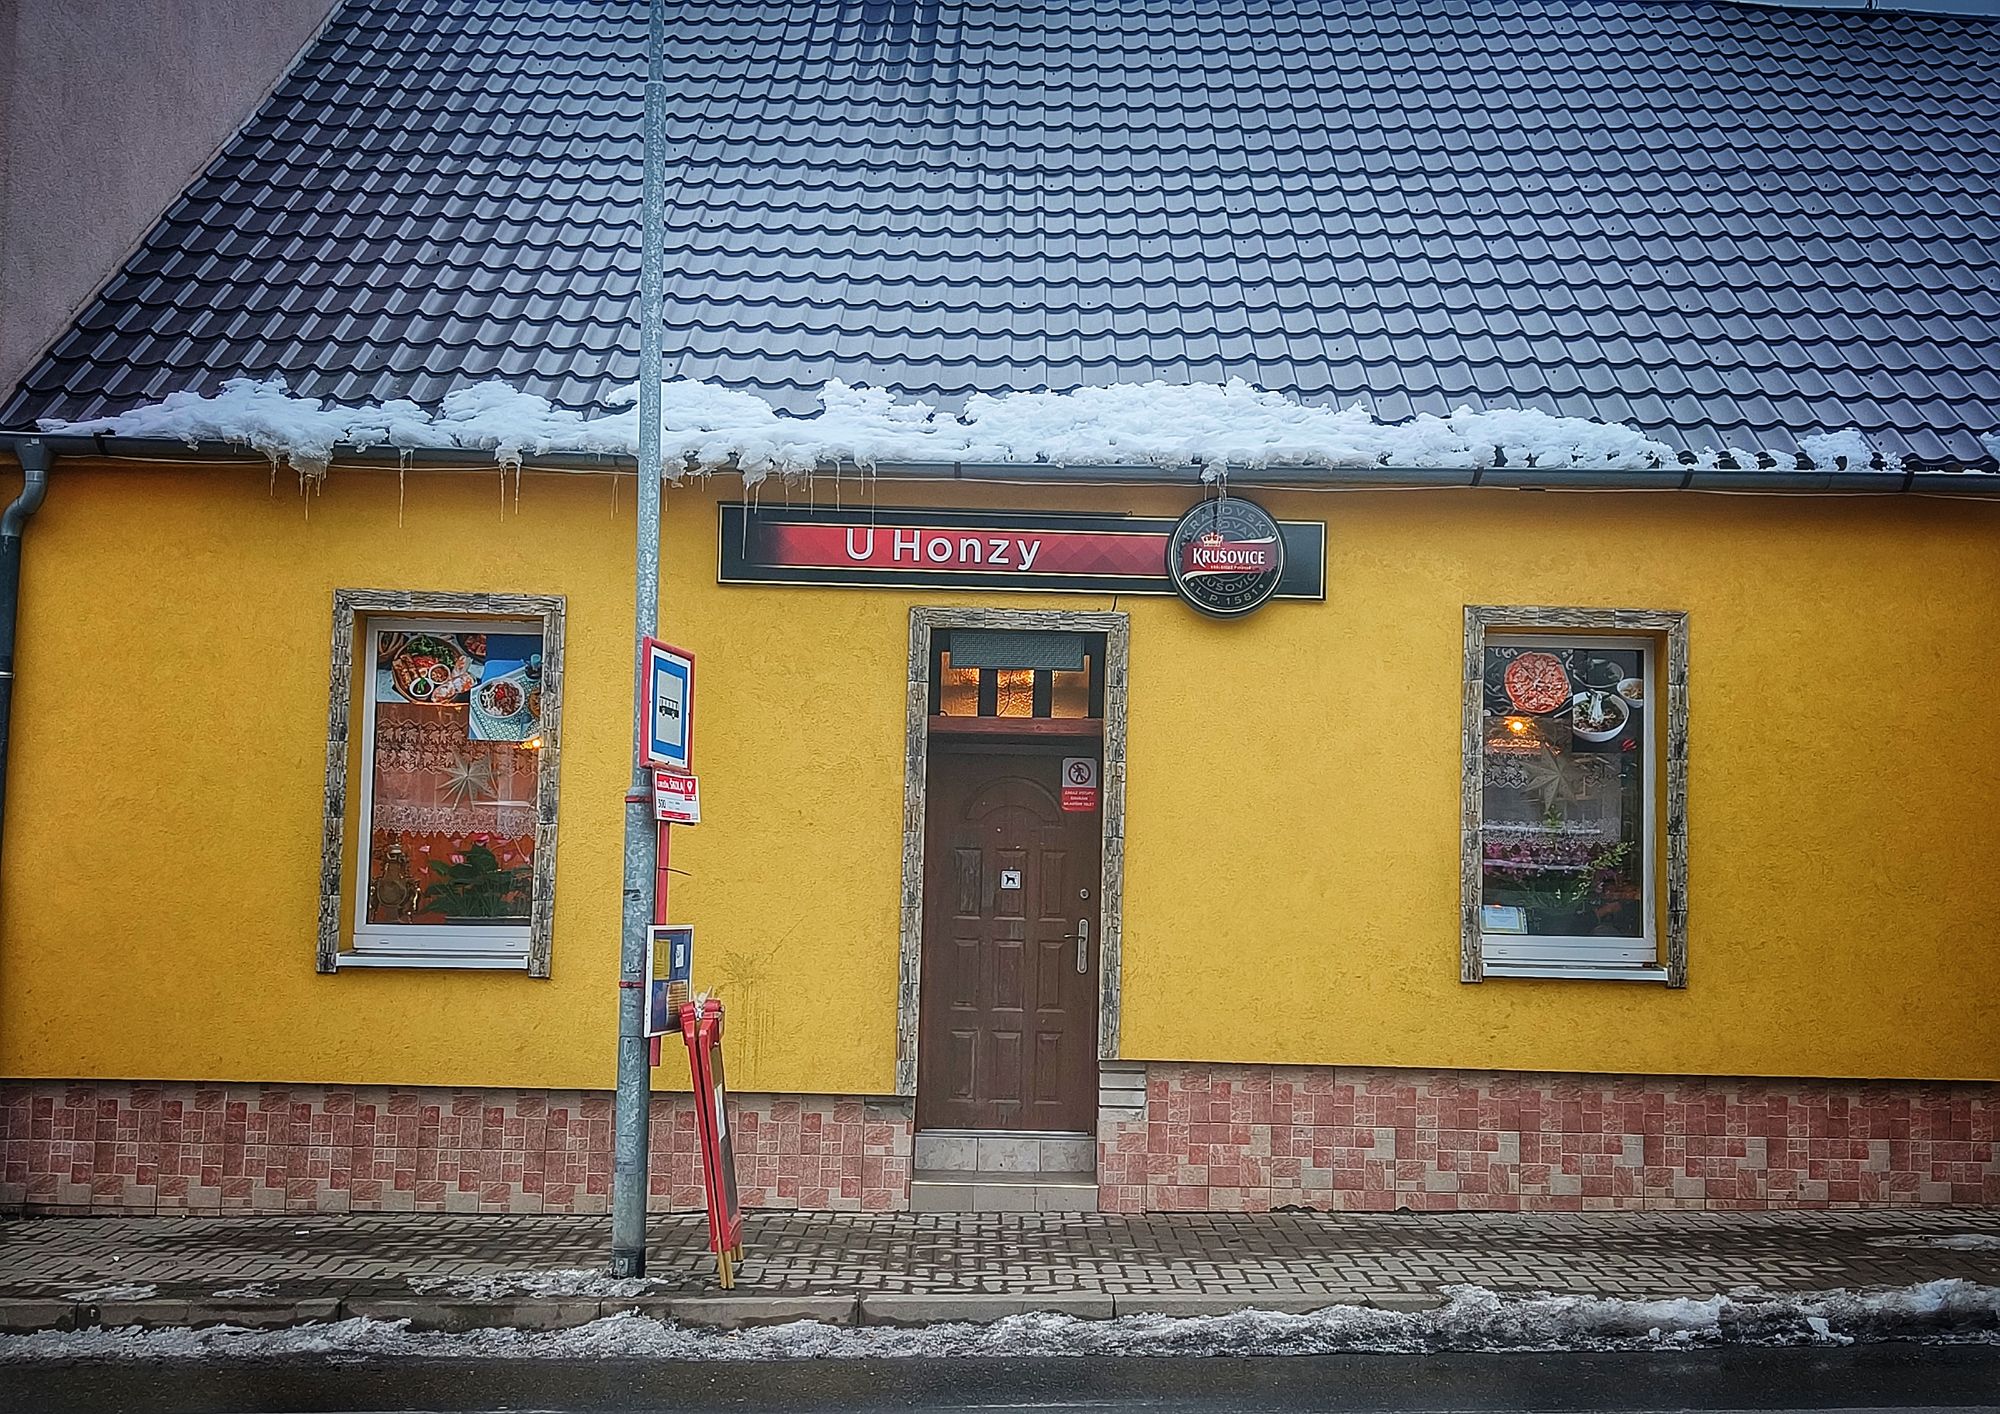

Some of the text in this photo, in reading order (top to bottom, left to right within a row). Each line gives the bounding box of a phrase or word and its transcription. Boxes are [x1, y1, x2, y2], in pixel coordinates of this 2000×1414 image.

[846, 528, 1041, 571] U Honzy
[1193, 547, 1265, 568] KRUŠOVICE
